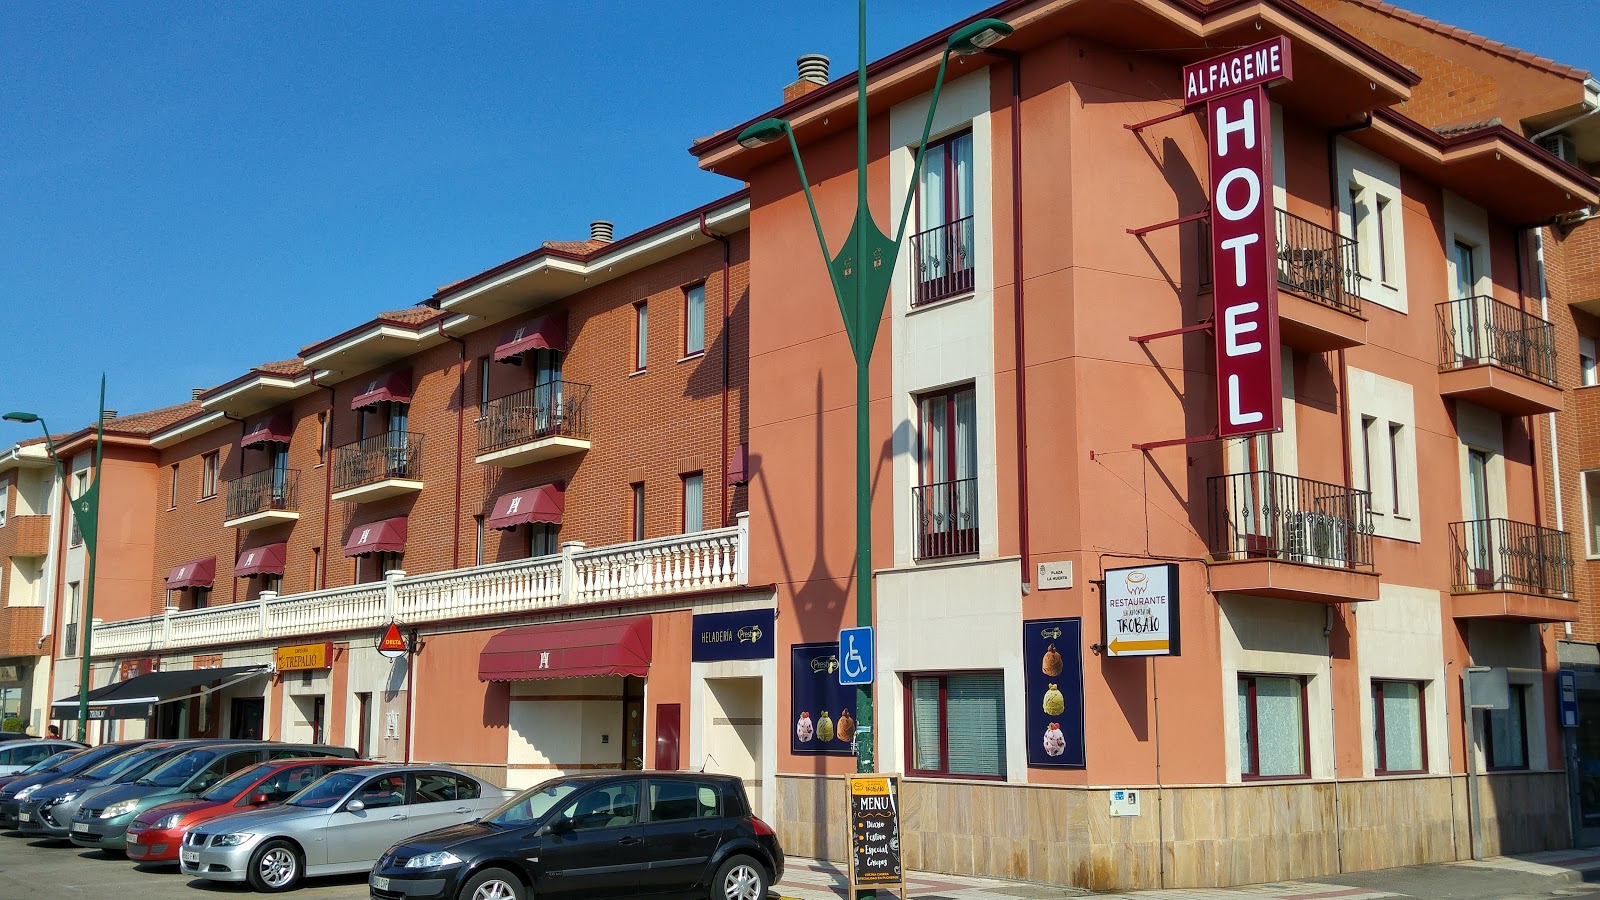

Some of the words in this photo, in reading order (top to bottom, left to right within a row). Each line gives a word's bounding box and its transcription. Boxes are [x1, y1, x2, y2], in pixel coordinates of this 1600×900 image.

[1187, 45, 1281, 97] ALFAGEME
[1215, 98, 1263, 427] HOTEL
[1110, 596, 1166, 607] RESTAURANTE
[701, 628, 733, 643] HELADERÍA
[285, 653, 317, 668] TREPALIO
[860, 797, 889, 810] MENU
